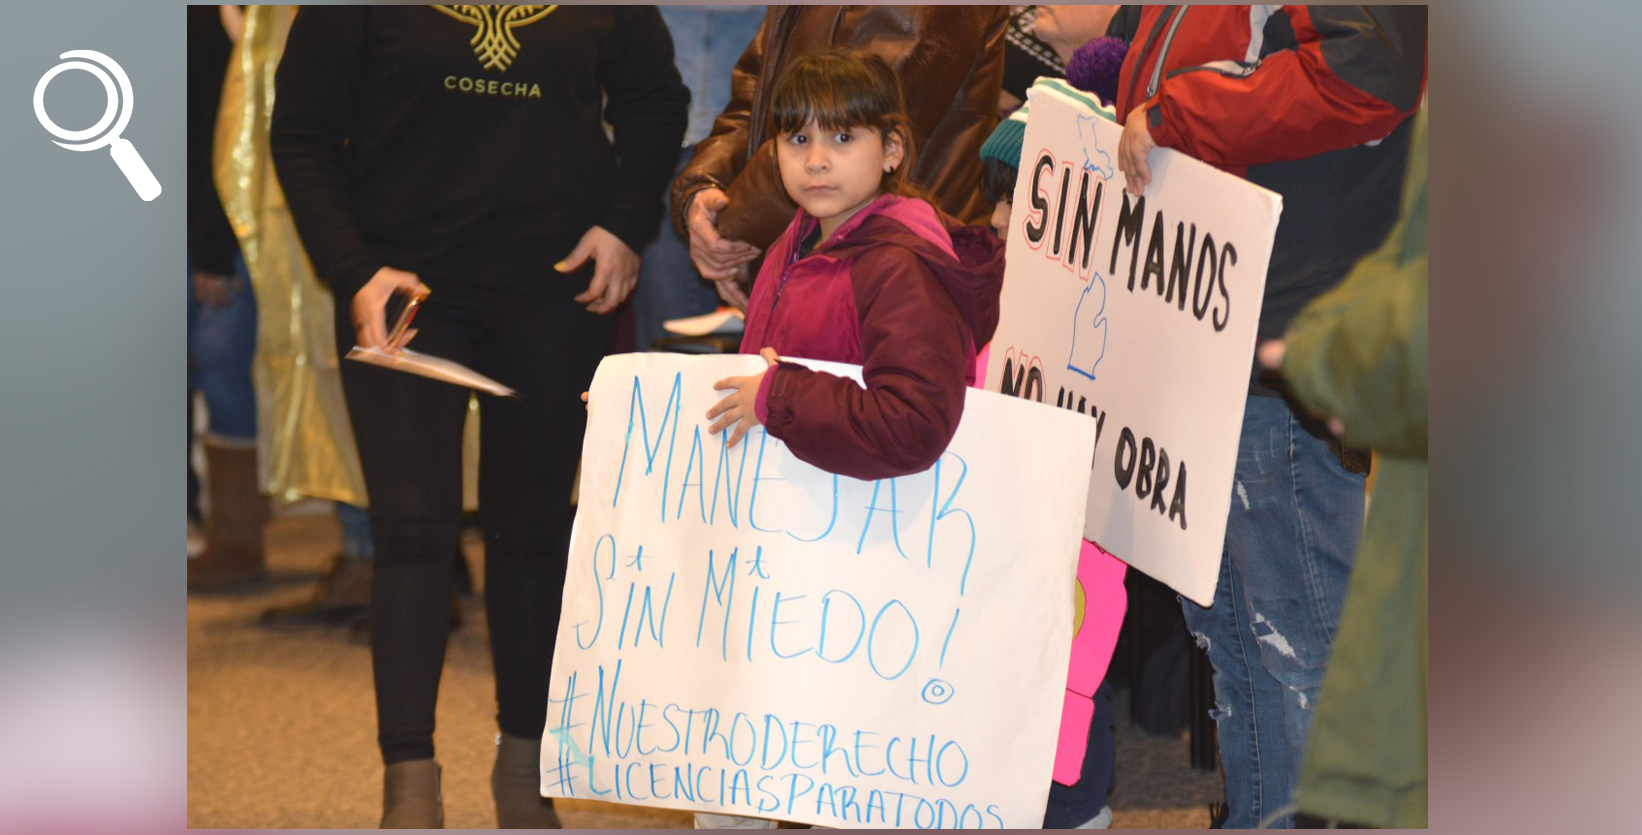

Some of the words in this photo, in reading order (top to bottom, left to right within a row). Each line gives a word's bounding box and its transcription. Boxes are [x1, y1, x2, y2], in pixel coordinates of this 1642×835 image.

[444, 76, 541, 97] COSECHA
[1025, 153, 1103, 270] SIN
[1109, 187, 1237, 332] MANOS
[1114, 426, 1187, 530] OBRA
[548, 659, 969, 787] #NUESTRODERECHO
